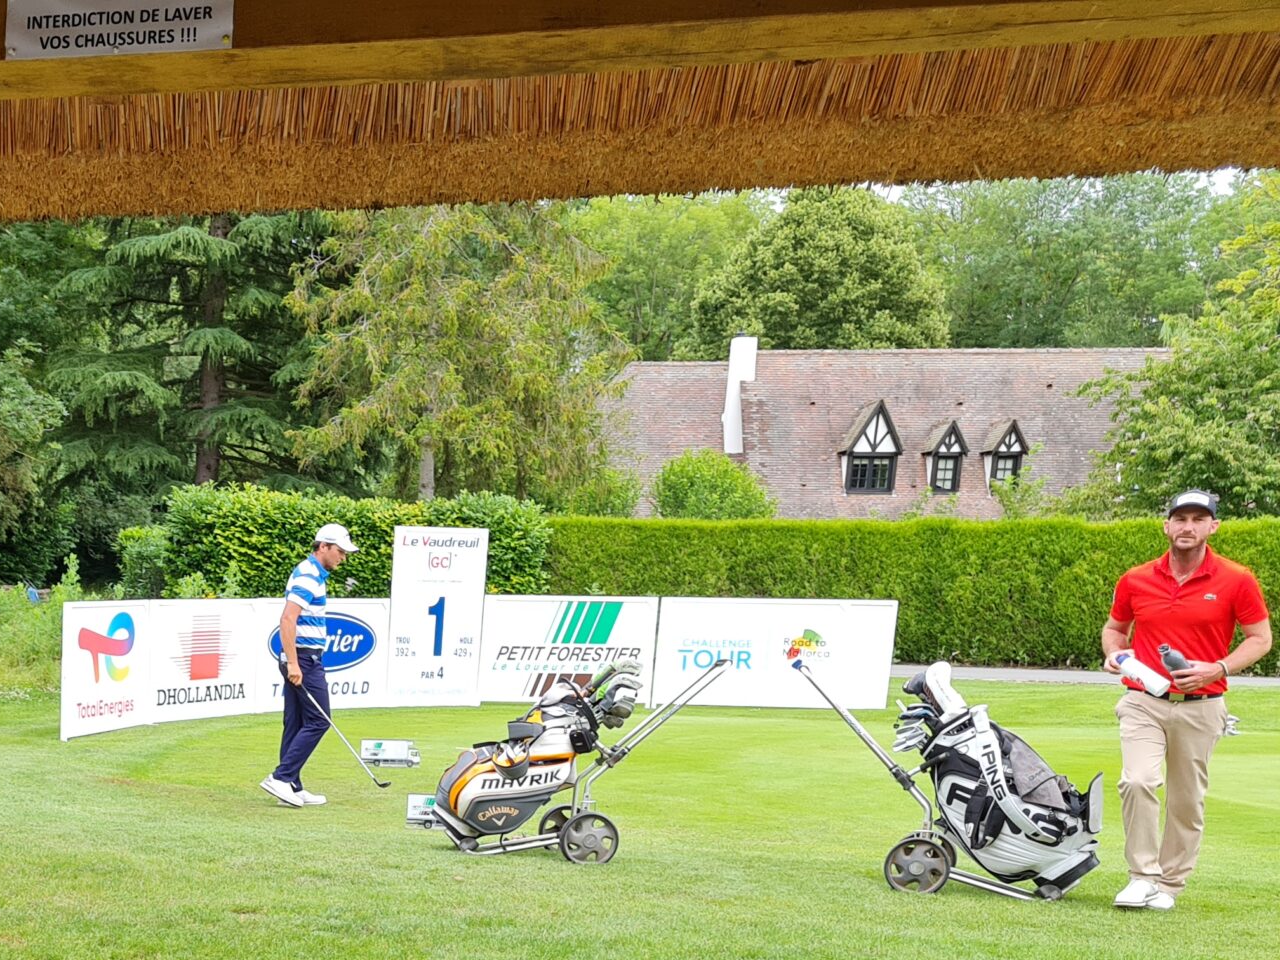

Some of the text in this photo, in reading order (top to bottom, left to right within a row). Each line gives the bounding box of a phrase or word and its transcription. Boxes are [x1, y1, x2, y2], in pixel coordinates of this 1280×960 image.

[26, 6, 213, 30] INTERDICTION DE LAVER
[39, 27, 198, 50] VOS CHAUSSURES !!!
[402, 535, 480, 548] Le Vaudreuil
[427, 596, 446, 657] 1
[682, 638, 753, 648] CHALLENGE
[783, 637, 827, 647] Road to
[395, 647, 409, 657] 392
[453, 647, 468, 657] 429
[496, 645, 641, 662] PETIT FORESTIER
[677, 649, 752, 671] TOUR
[782, 648, 831, 659] Mallorca
[420, 666, 444, 679] PAR 4
[156, 682, 247, 707] DHOLLANDIA
[76, 698, 135, 720] TotalEnergies
[481, 769, 562, 790] MAVRIK
[981, 750, 1007, 802] PING
[477, 804, 520, 821] Callaway
